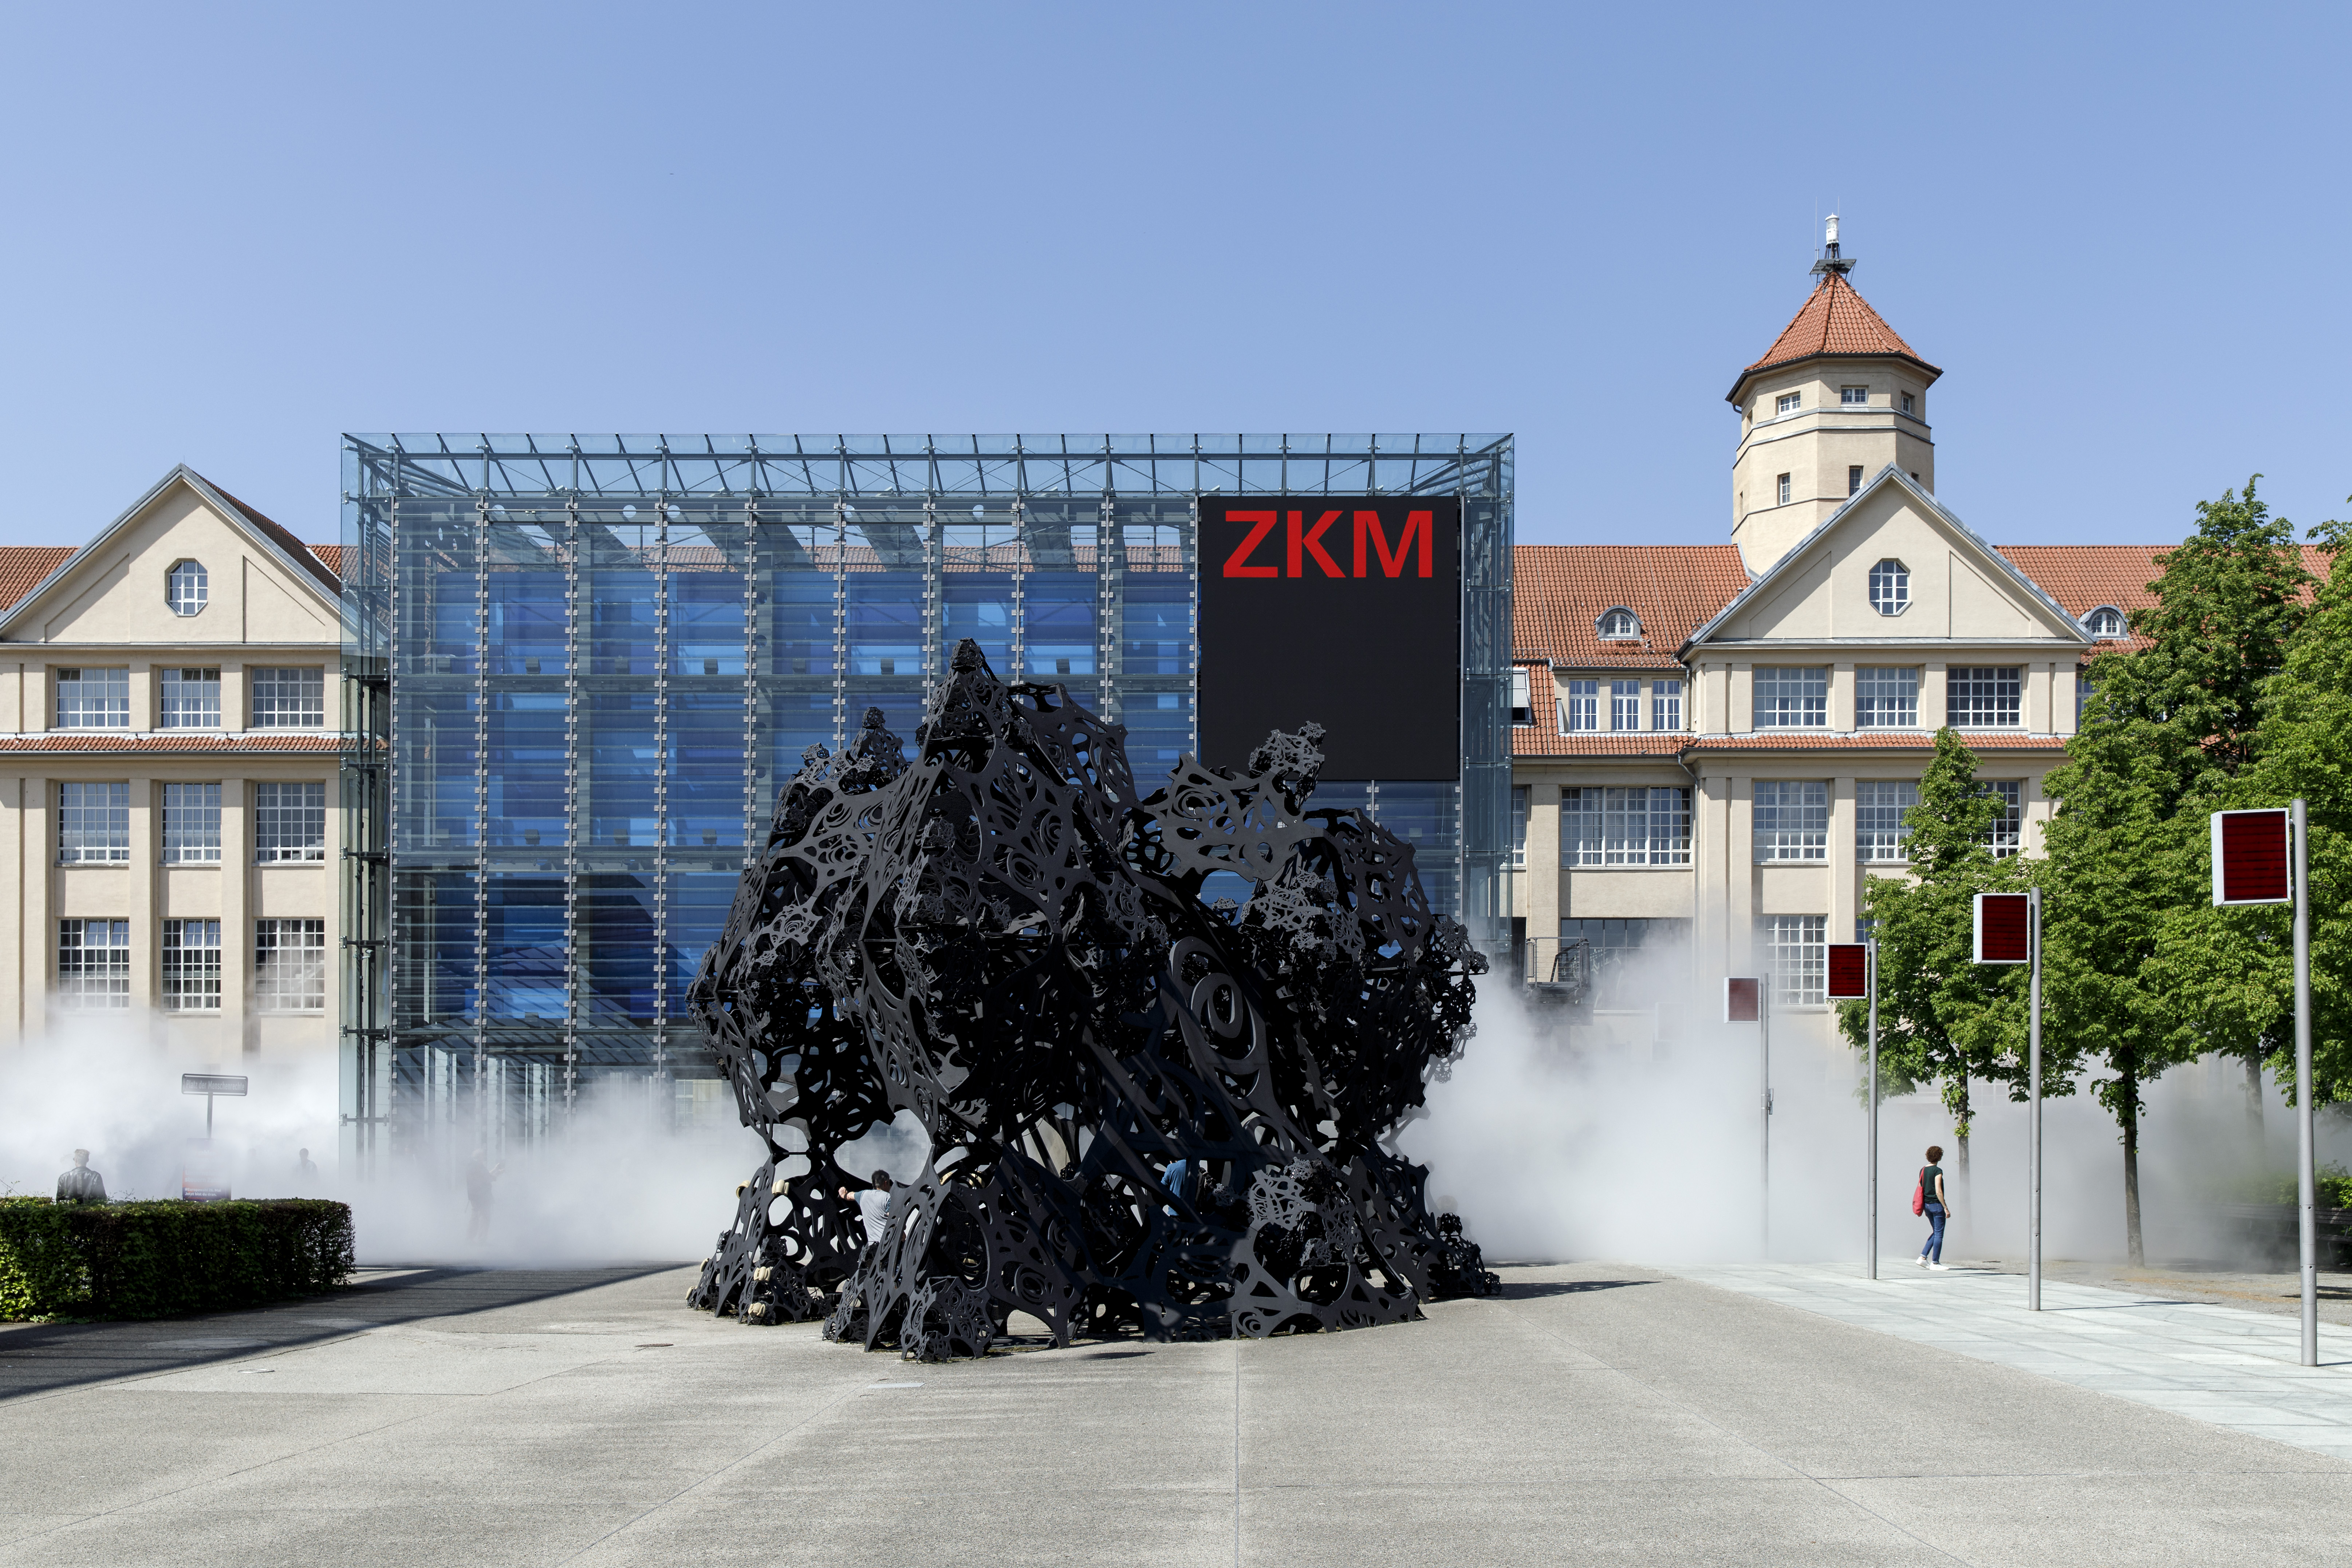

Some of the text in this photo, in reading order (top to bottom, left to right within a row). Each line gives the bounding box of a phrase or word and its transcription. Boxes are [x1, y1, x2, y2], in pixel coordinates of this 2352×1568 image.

[1223, 510, 1433, 578] ZKM
[186, 1080, 198, 1089] Platz
[208, 1081, 245, 1090] Menschenrechte
